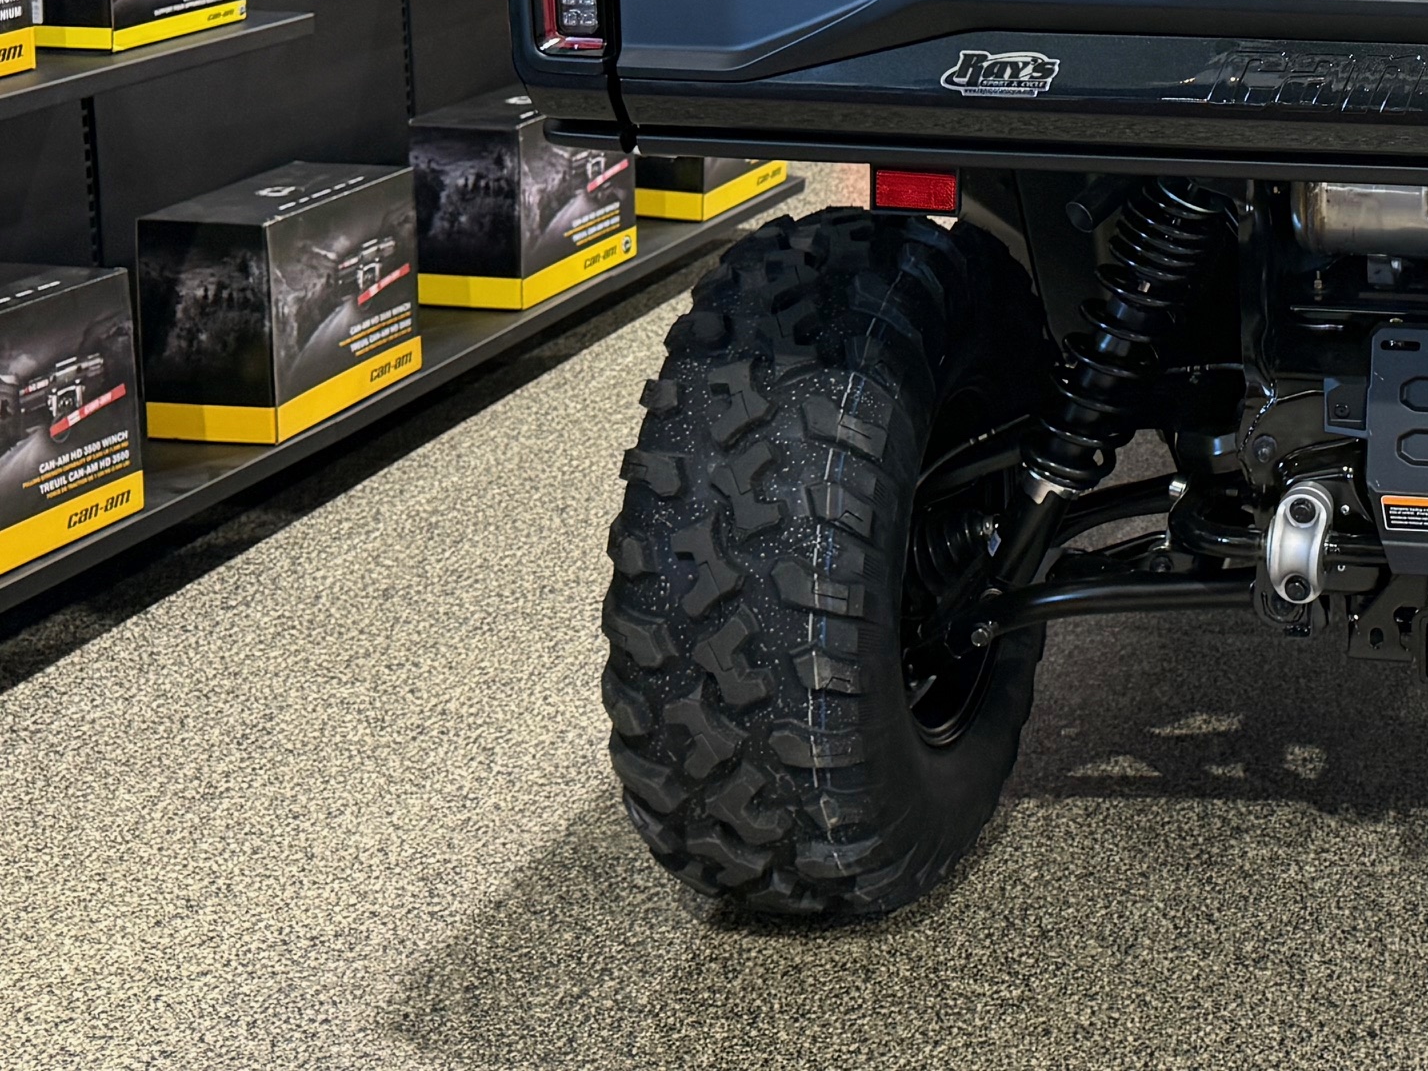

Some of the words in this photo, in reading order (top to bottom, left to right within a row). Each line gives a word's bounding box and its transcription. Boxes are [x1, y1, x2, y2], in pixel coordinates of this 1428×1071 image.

[369, 351, 413, 383] can-am
[39, 453, 70, 474] CAN-AM
[70, 448, 83, 461] HD
[83, 441, 102, 455] 3500
[102, 430, 128, 448] WINCH
[39, 475, 67, 494] TREUIL
[68, 462, 99, 482] CAN-AM
[99, 457, 112, 470] HD
[112, 450, 130, 464] 3500
[67, 489, 132, 530] can-am
